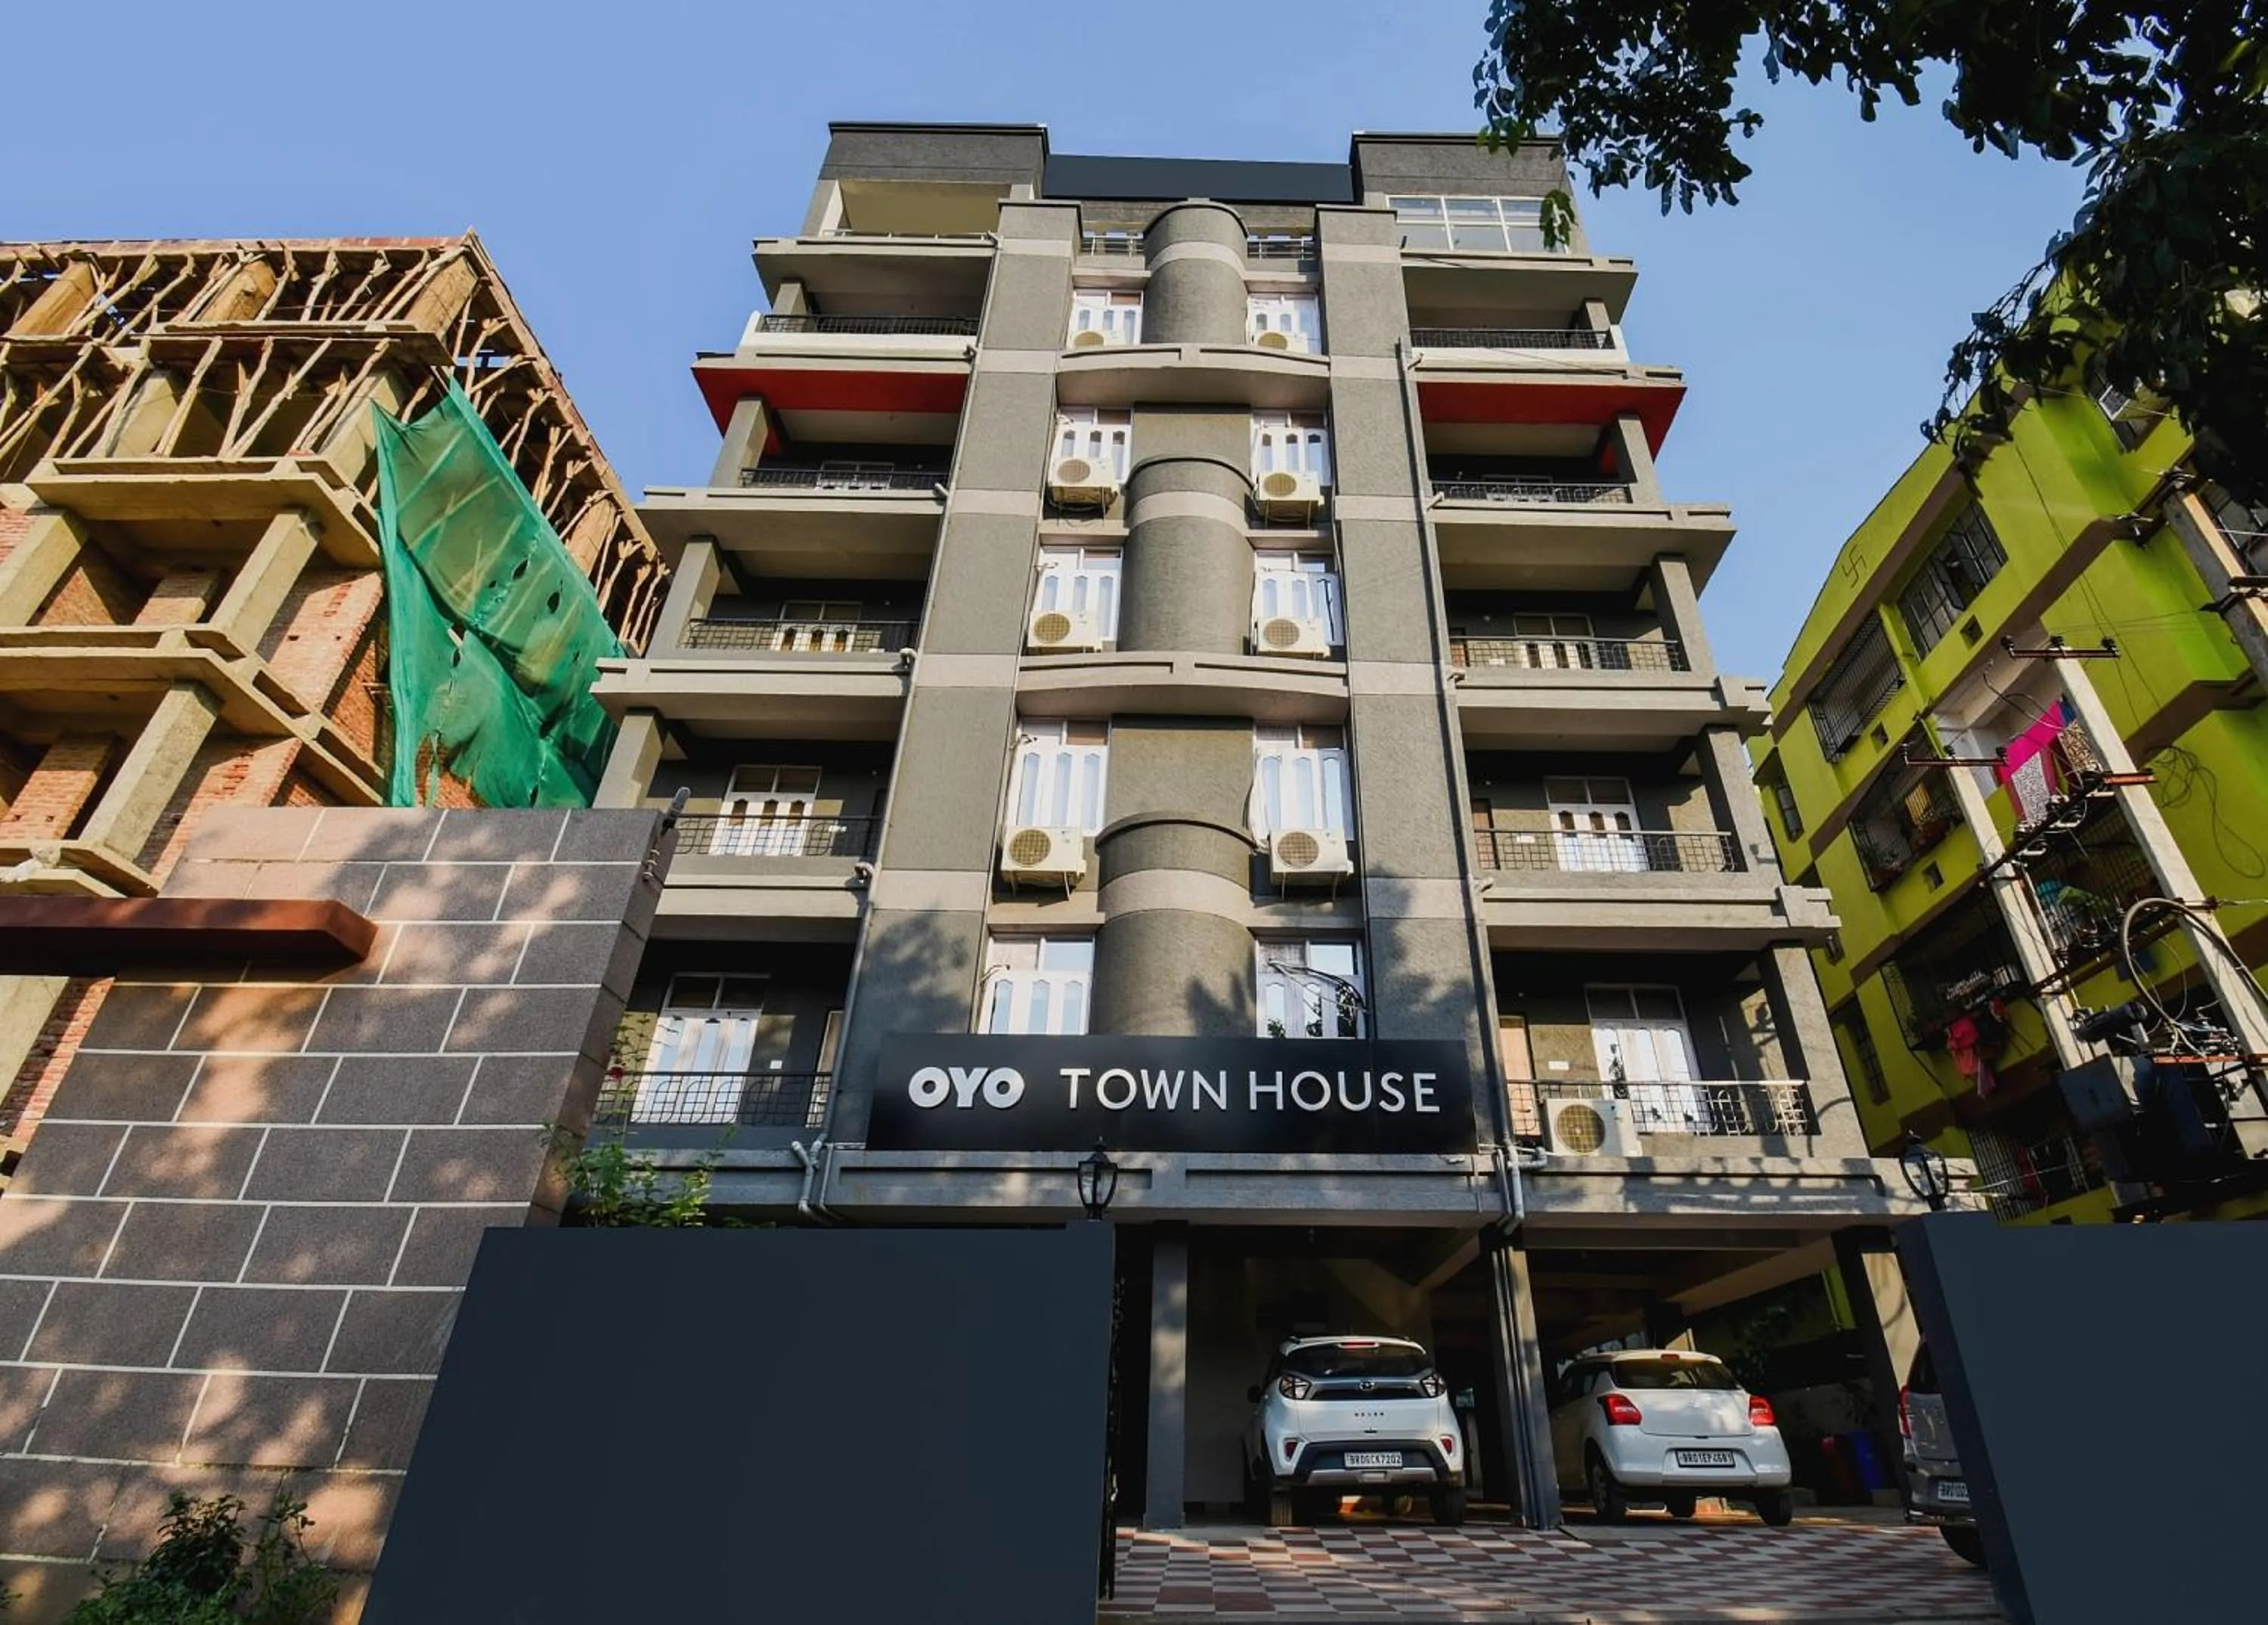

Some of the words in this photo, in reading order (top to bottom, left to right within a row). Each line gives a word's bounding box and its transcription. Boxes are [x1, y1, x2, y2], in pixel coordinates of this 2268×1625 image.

[908, 1066, 1026, 1109] OYO
[1060, 1067, 1227, 1110] TOWN
[1249, 1070, 1440, 1113] HOUSE
